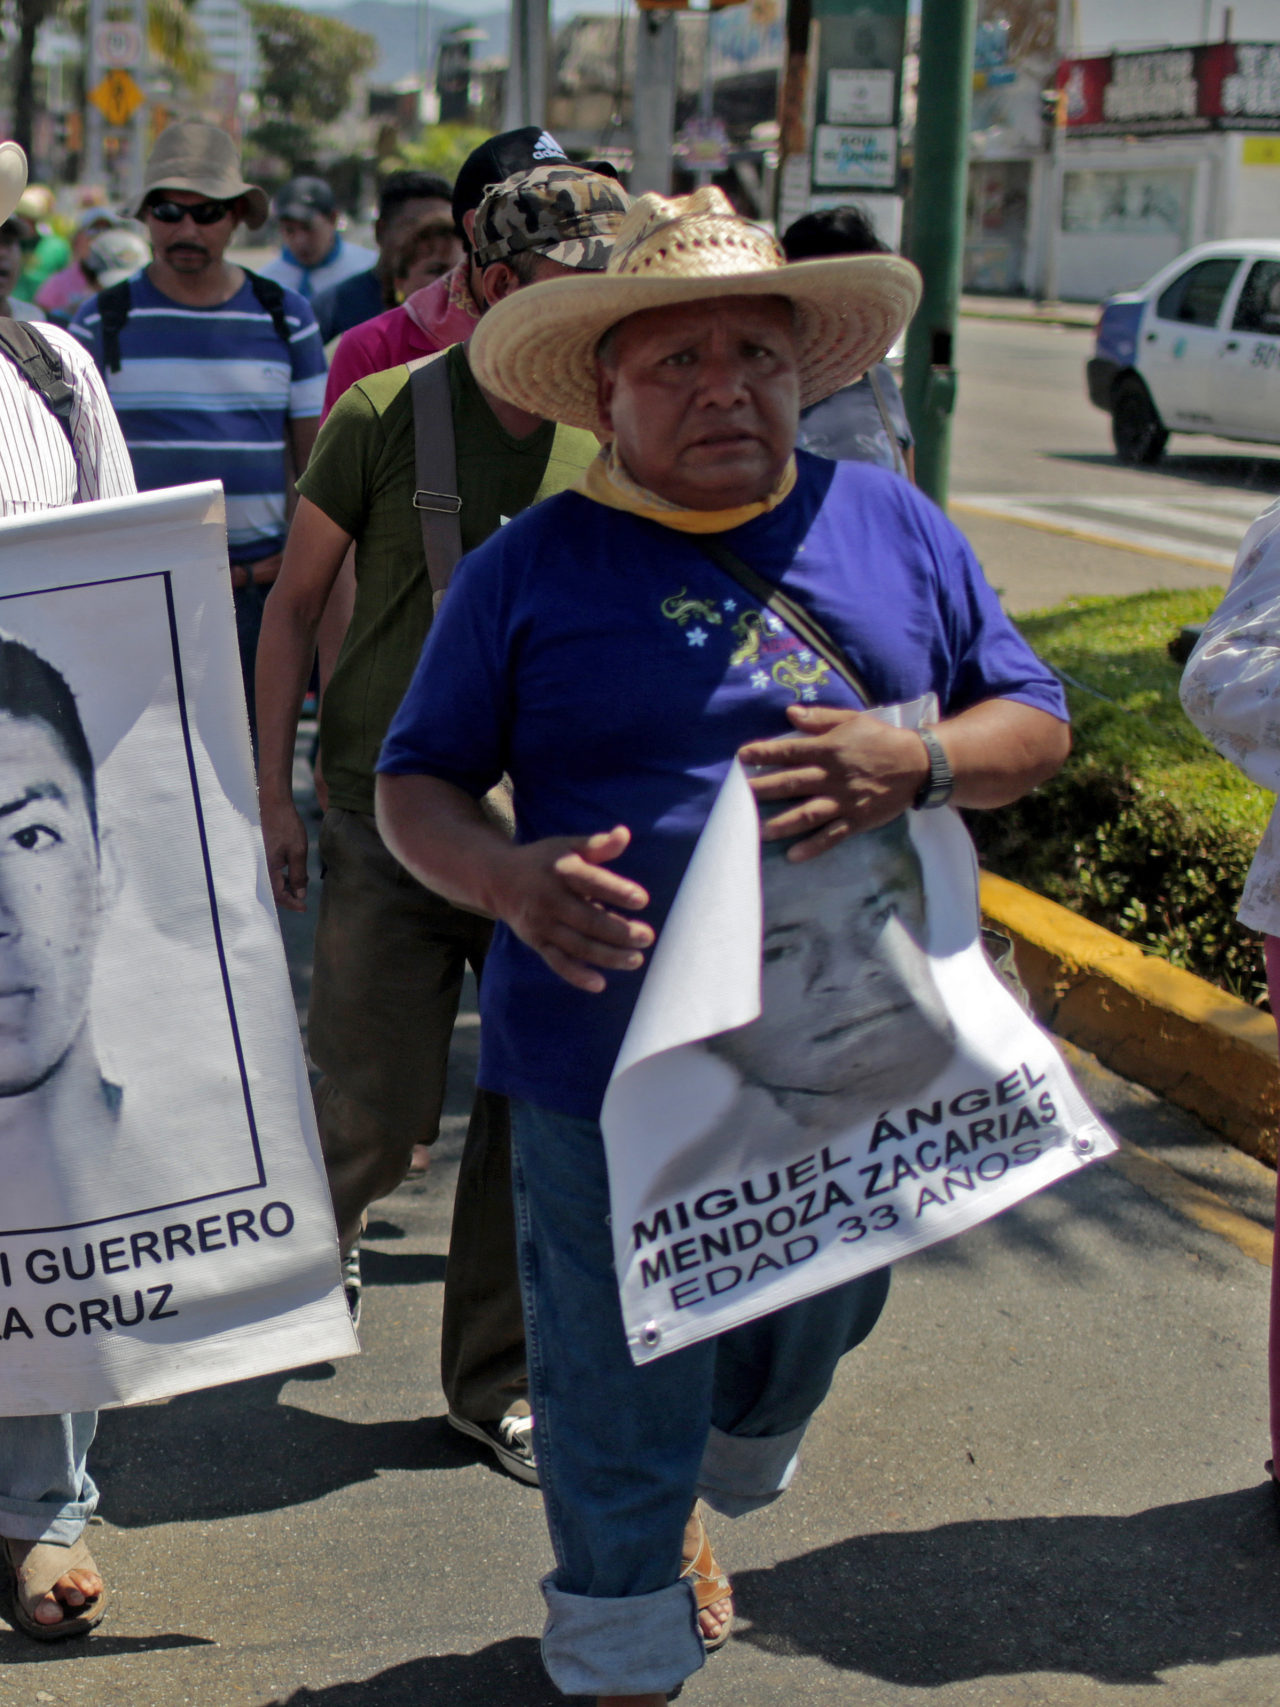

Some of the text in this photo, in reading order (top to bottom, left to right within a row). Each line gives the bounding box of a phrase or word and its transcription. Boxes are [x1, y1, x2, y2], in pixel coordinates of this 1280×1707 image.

[632, 1061, 1046, 1250] MIGUEL ÁNGEL
[639, 1090, 1058, 1289] MENDOZA ZACARIAS
[669, 1138, 1043, 1311] EDAD 33 AÑOS
[24, 1200, 295, 1285] GUERRERO
[44, 1283, 179, 1336] CRUZ
